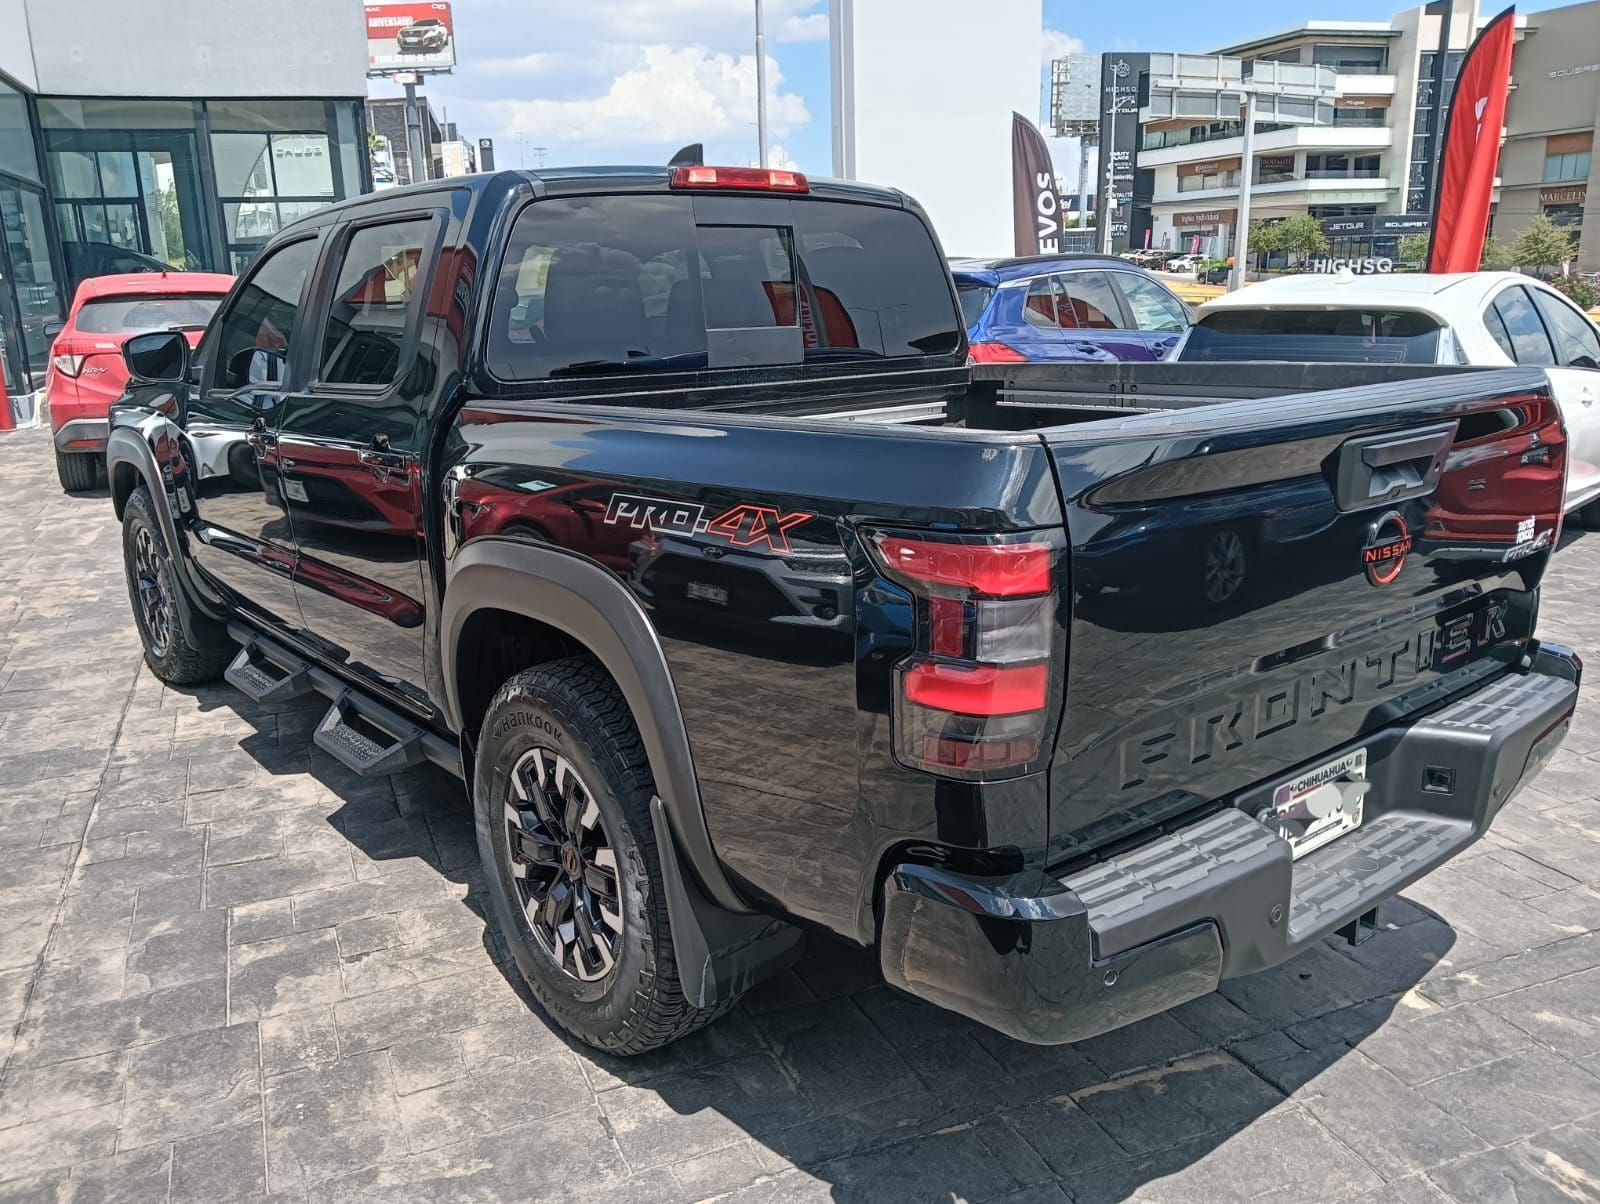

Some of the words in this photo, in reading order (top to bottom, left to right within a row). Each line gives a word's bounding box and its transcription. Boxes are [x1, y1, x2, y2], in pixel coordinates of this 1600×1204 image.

[1037, 172, 1058, 254] EVOS
[1330, 222, 1364, 230] JETOUR
[1365, 536, 1411, 562] NISSAN
[1119, 595, 1506, 791] FRONTIER
[1297, 761, 1347, 792] CHIHUAHUA
